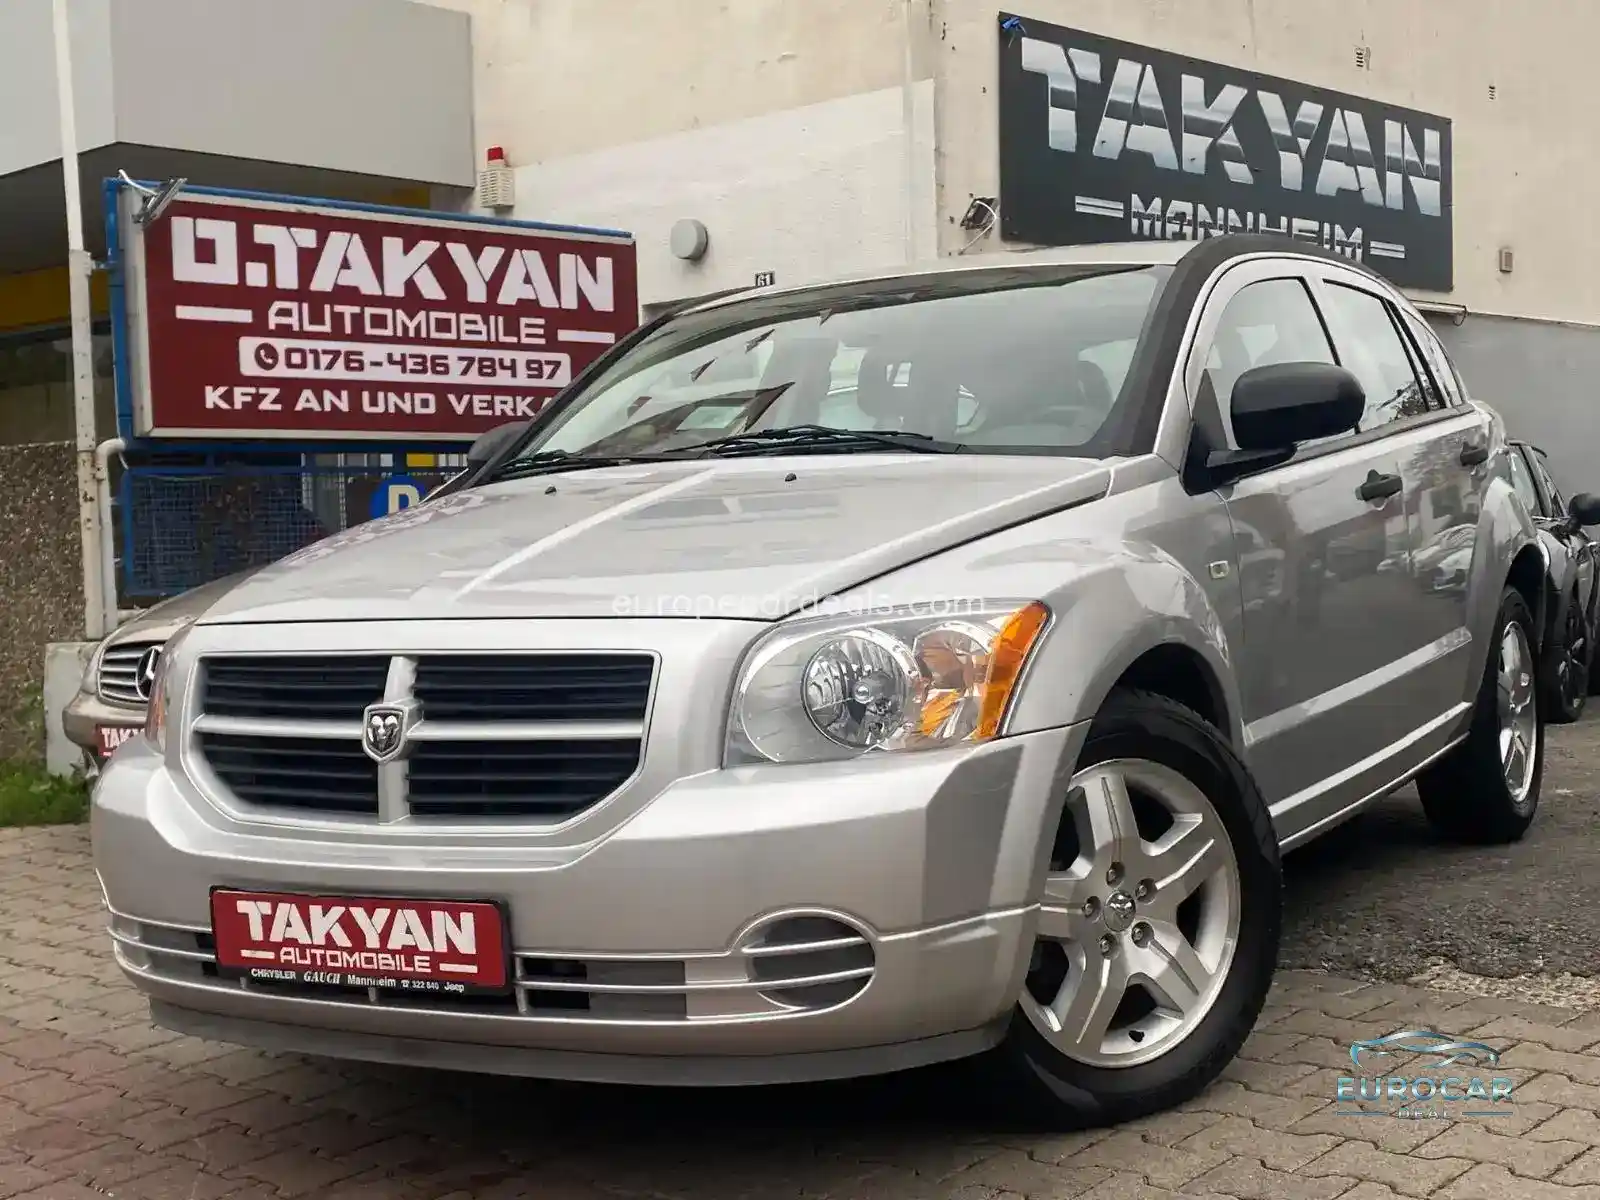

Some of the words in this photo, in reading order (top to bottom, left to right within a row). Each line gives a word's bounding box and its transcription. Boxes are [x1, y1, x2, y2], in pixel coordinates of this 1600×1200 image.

[1021, 37, 1441, 216] TAKYAN
[268, 300, 546, 344] AUTOMOBILE
[458, 356, 517, 378] 784
[526, 359, 562, 380] 97
[204, 386, 282, 410] KFZ
[295, 389, 349, 413] AN
[362, 391, 436, 415] UND
[236, 900, 477, 955] TAKYAN
[280, 947, 432, 973] AUTOMOBILE
[251, 967, 296, 980] CHRYSLER
[303, 970, 341, 985] GAUCH
[411, 980, 425, 989] 322
[444, 982, 465, 993] Jeep
